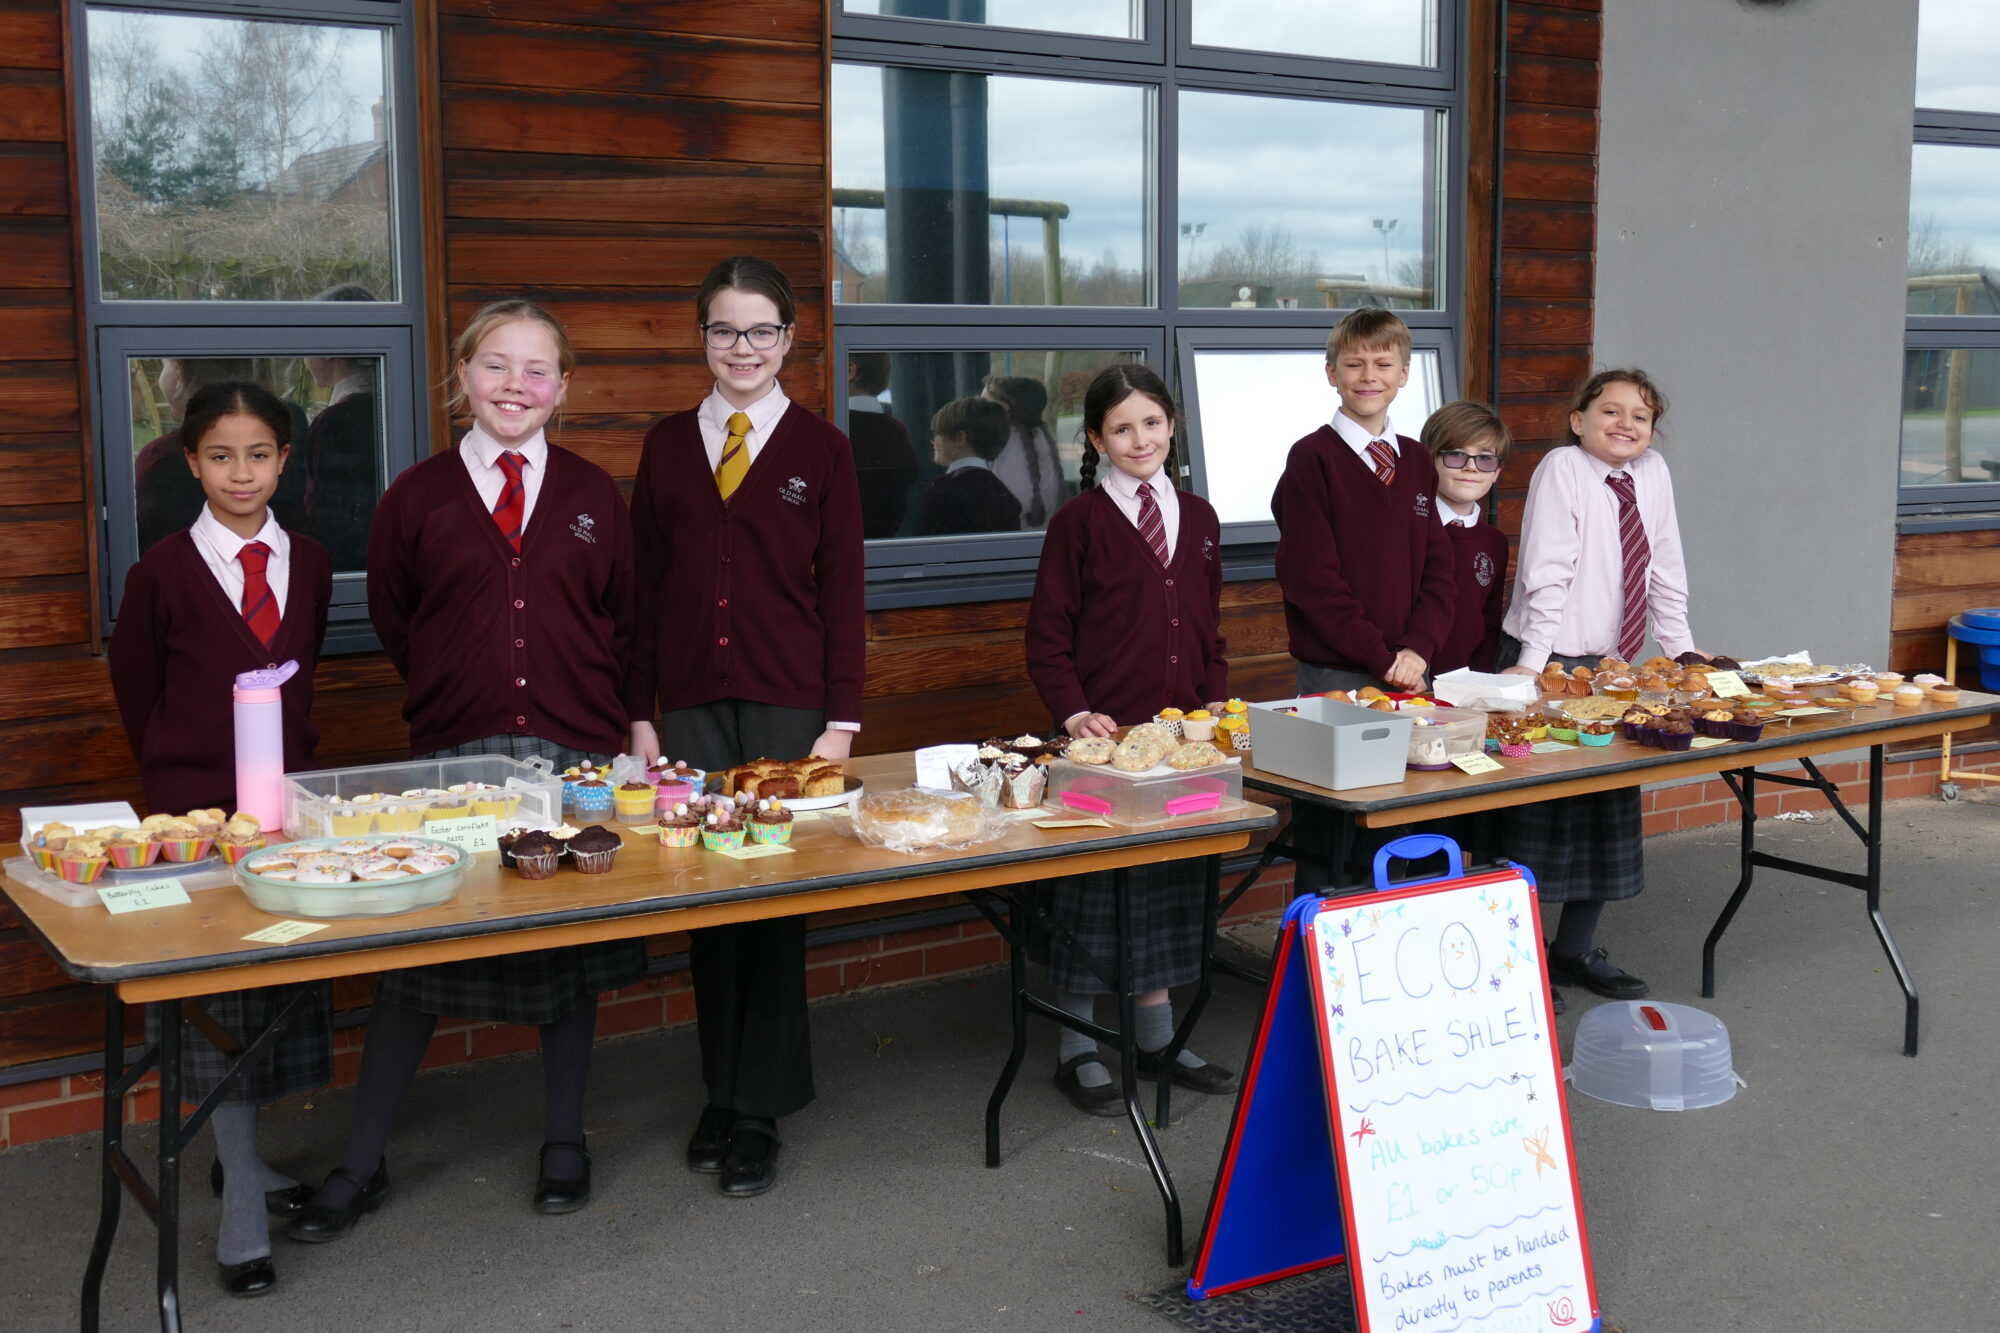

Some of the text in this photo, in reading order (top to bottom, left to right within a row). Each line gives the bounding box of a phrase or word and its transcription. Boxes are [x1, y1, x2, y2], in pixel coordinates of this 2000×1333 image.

[779, 487, 792, 496] OLD
[430, 825, 452, 835] Easter
[1351, 921, 1481, 1005] ECO
[1349, 991, 1541, 1083] BAKE SALE!
[1370, 1116, 1523, 1171] All bakes are
[1386, 1162, 1522, 1224] £1 or 50p
[1379, 1224, 1570, 1300] Bakes must be handed
[1395, 1263, 1543, 1331] directly to parents
